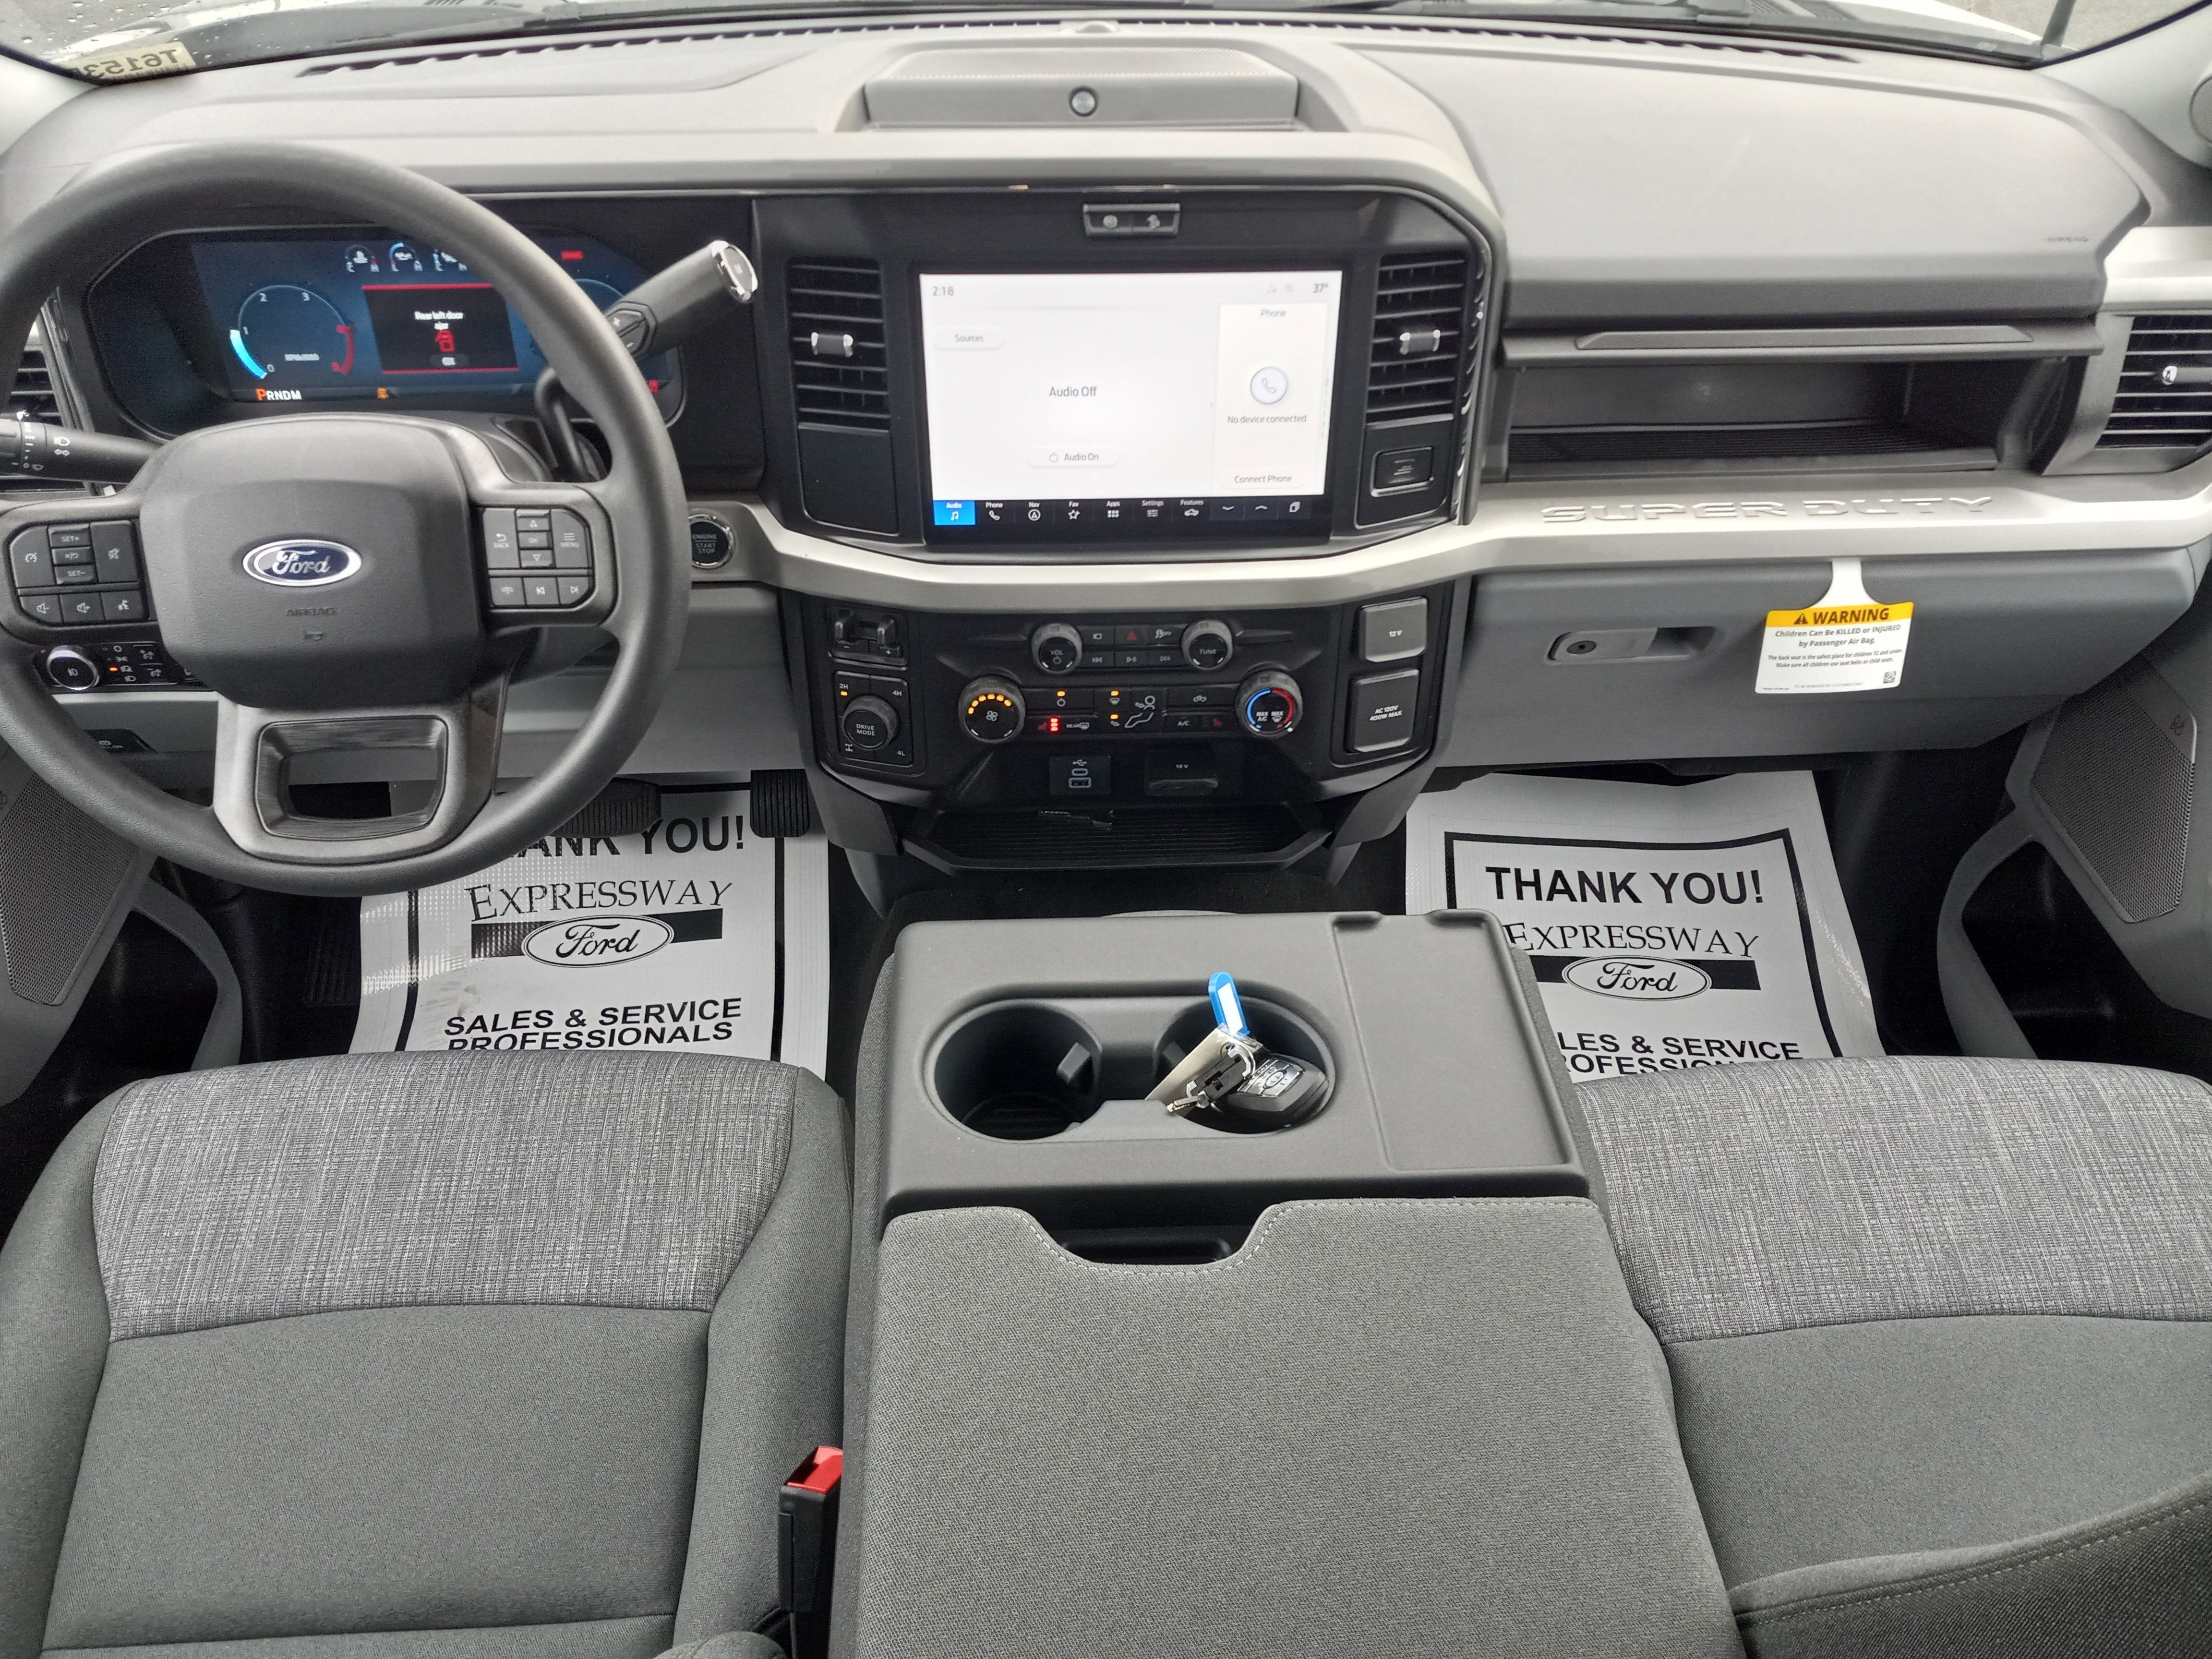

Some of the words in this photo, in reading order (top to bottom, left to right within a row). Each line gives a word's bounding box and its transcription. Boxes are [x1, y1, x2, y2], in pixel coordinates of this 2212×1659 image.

[259, 292, 268, 302] 2
[301, 291, 311, 302] 3
[933, 286, 954, 296] 2:18
[1260, 309, 1286, 317] Phone
[955, 334, 984, 343] Sources
[266, 363, 275, 373] 0
[1049, 386, 1079, 397] Audio
[1081, 386, 1097, 397] Off
[1227, 416, 1238, 424] No
[1240, 415, 1265, 424] device
[1266, 415, 1307, 423] connected
[1088, 453, 1099, 461] On
[1234, 475, 1266, 483] Connect
[1267, 475, 1292, 483] Phone
[1541, 500, 1788, 523] SUPER
[1803, 496, 1993, 517] DUTY
[272, 550, 331, 575] Ford
[1813, 608, 1890, 625] WARNING
[1872, 624, 1901, 633] INJURED
[1861, 637, 1876, 645] Bag.
[640, 815, 744, 855] YOU!
[1485, 866, 1643, 904] THANK
[1649, 869, 1764, 905] YOU!
[464, 879, 733, 922] EXPRESSWAY
[555, 923, 641, 958] Ford
[1502, 922, 1759, 958] EXPRESSWAY
[1597, 962, 1679, 992] Ford
[444, 1008, 554, 1036] SALES
[565, 1009, 587, 1028] &
[599, 997, 742, 1026] SERVICE
[447, 1021, 733, 1050] PROFESSIONALS
[1631, 1035, 1655, 1054] &
[1662, 1036, 1803, 1061] SERVICE
